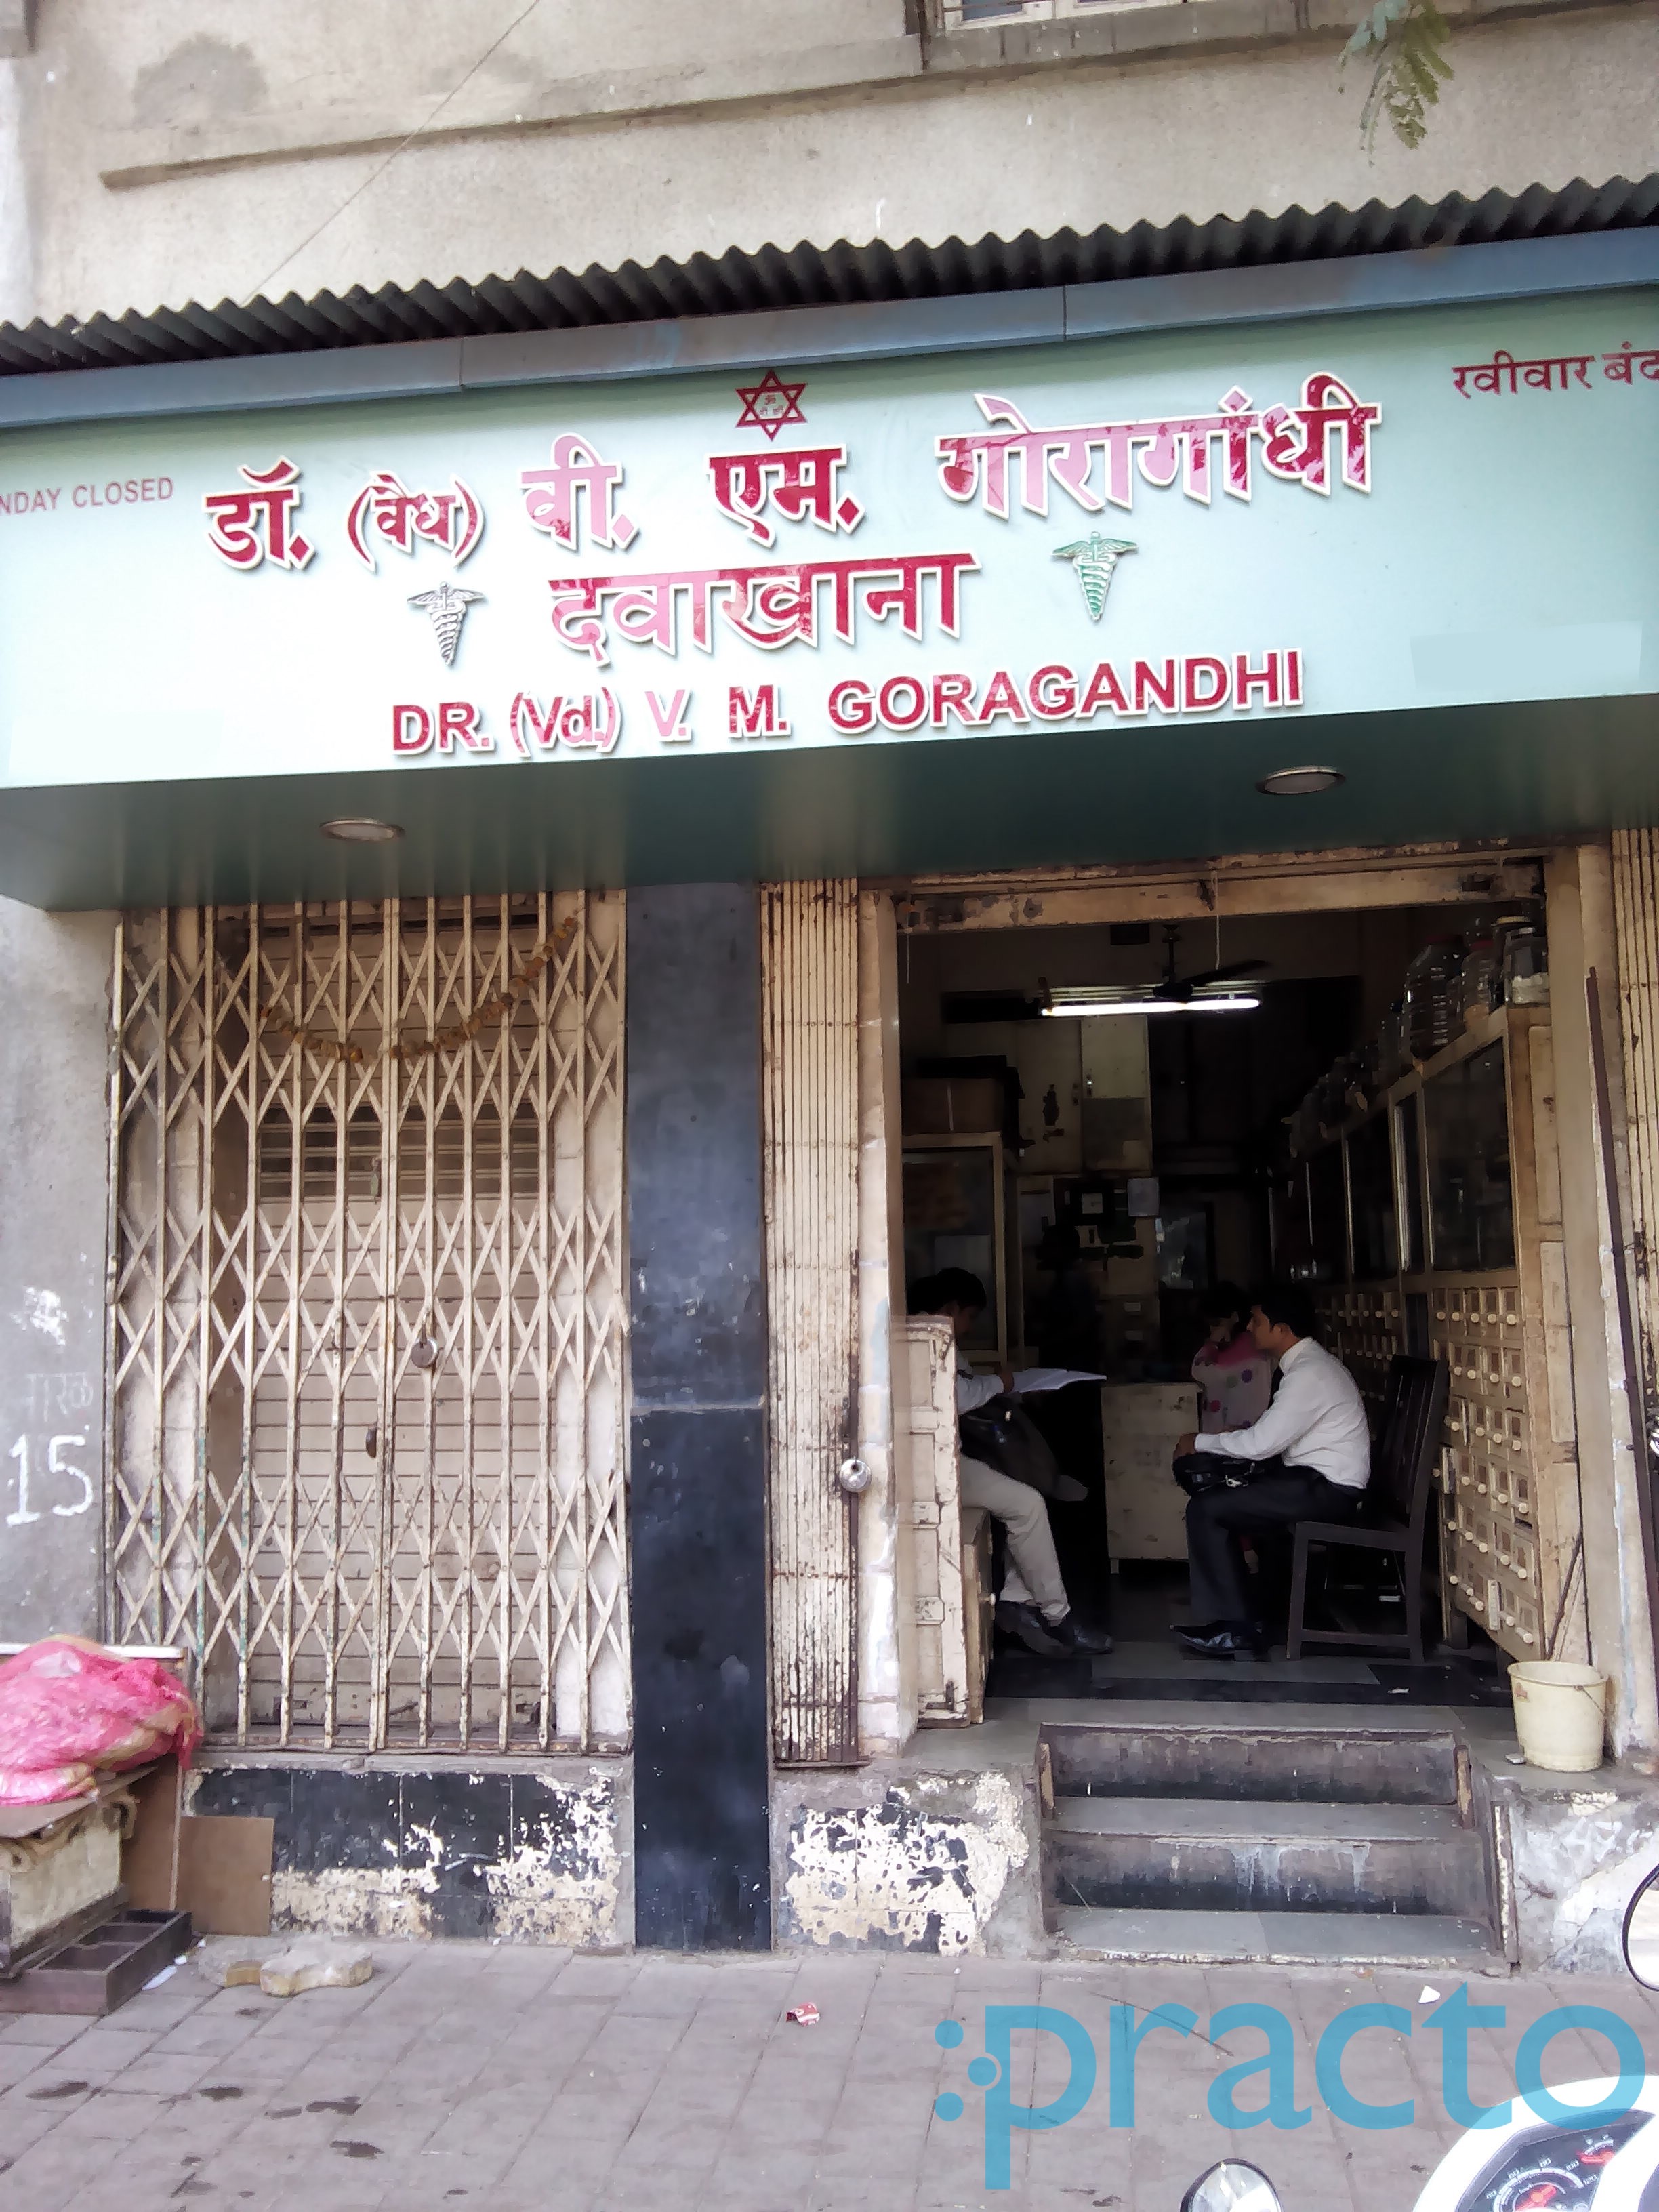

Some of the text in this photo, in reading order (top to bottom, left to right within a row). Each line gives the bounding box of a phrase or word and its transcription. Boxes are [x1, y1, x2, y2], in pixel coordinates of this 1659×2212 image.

[1451, 350, 1596, 400] रवीवार
[0, 476, 173, 516] NDAY CLOSED
[203, 459, 311, 565] डॉ.
[521, 436, 633, 543] वी.
[707, 446, 861, 542] एम.
[546, 551, 977, 663] दवाखाना
[391, 700, 491, 753] DR.
[644, 689, 687, 737] V.
[727, 682, 790, 735] M.
[826, 649, 1301, 731] GORAGANDHI
[6, 1433, 94, 1526] 15
